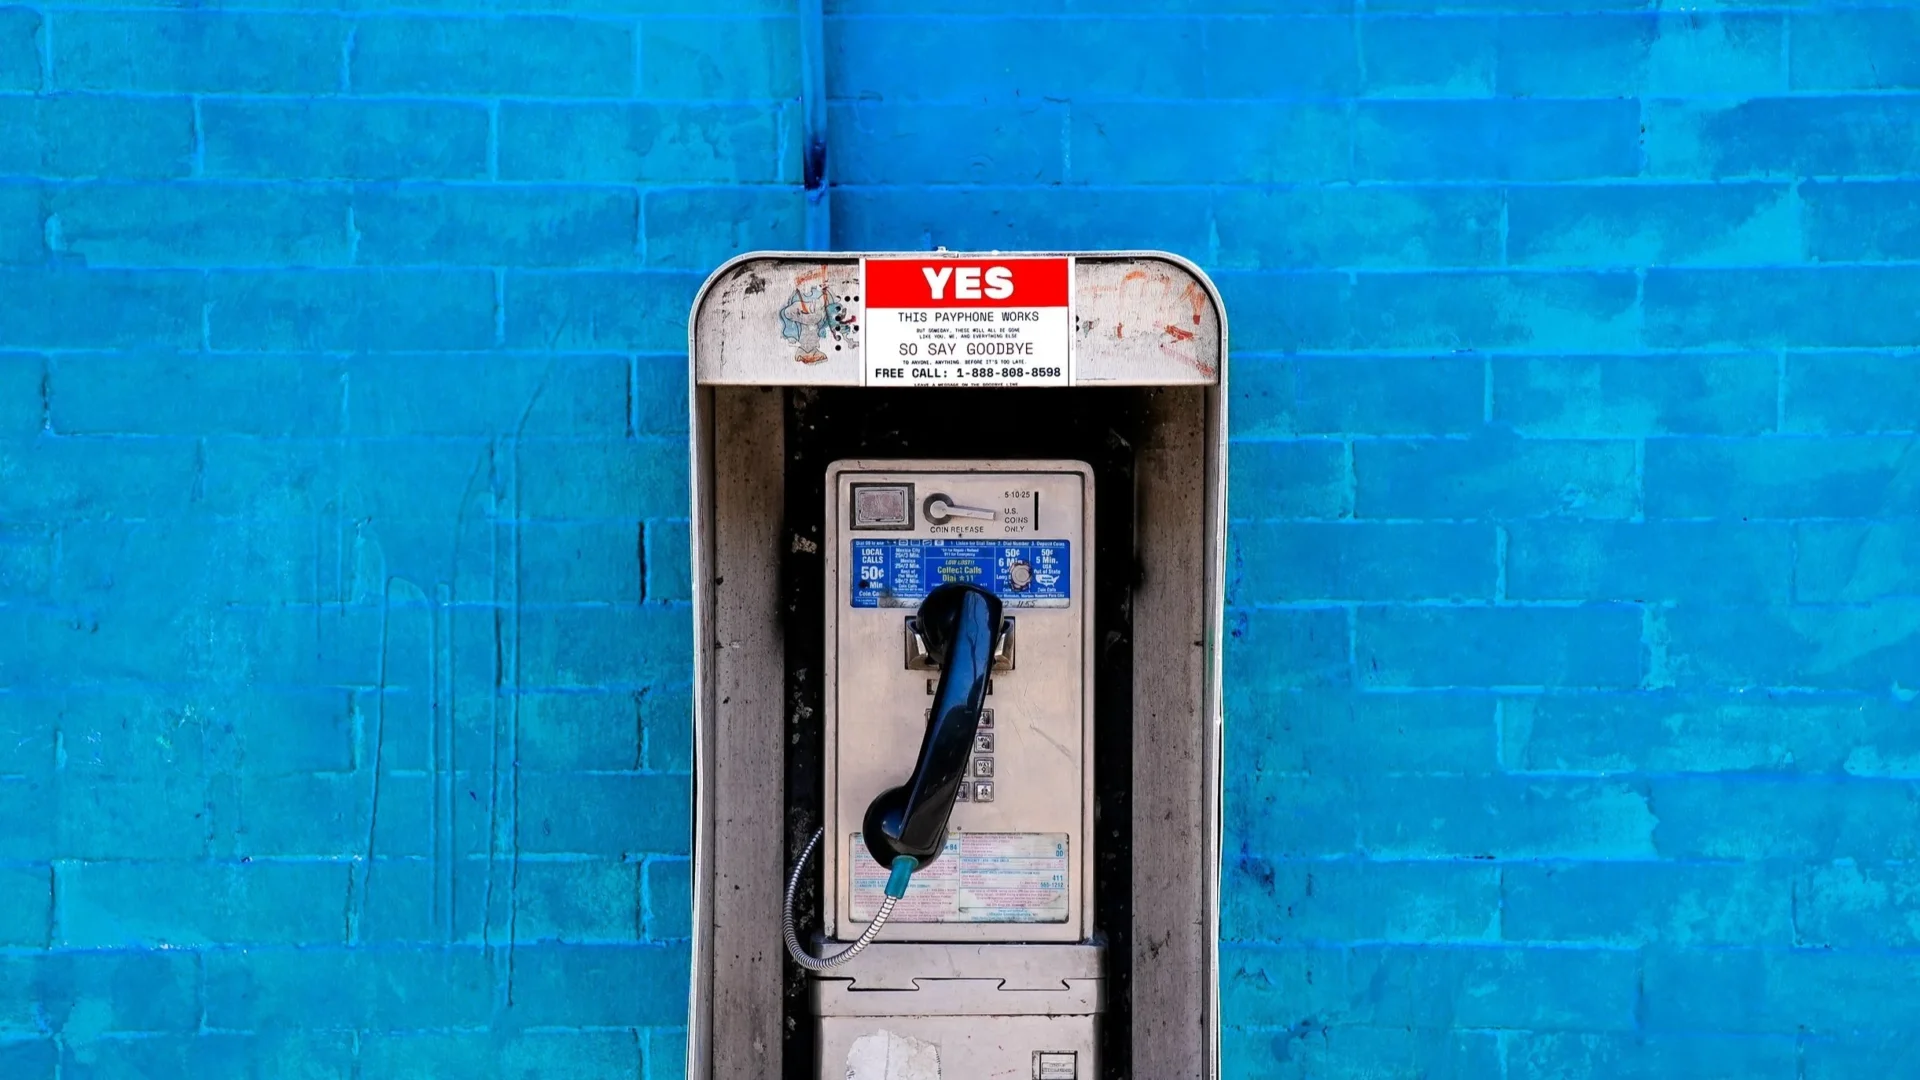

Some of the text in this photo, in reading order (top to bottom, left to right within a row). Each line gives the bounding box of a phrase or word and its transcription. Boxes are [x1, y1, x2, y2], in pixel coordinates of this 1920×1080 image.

[922, 266, 1014, 300] YES
[898, 311, 1039, 322] THIS PAYPHONE WORKS
[899, 342, 1033, 356] SO SAY GOODBYE
[875, 367, 1061, 378] FREE CALL: 1-888-808-8598
[862, 548, 884, 556] LOCAL
[1005, 548, 1021, 557] 50¢
[1041, 549, 1054, 557] 50¢
[862, 556, 884, 564] CALLS
[998, 558, 1004, 567] 6
[1042, 556, 1059, 564] Min.
[862, 566, 885, 580] 50¢
[937, 566, 982, 574] Collect Calls
